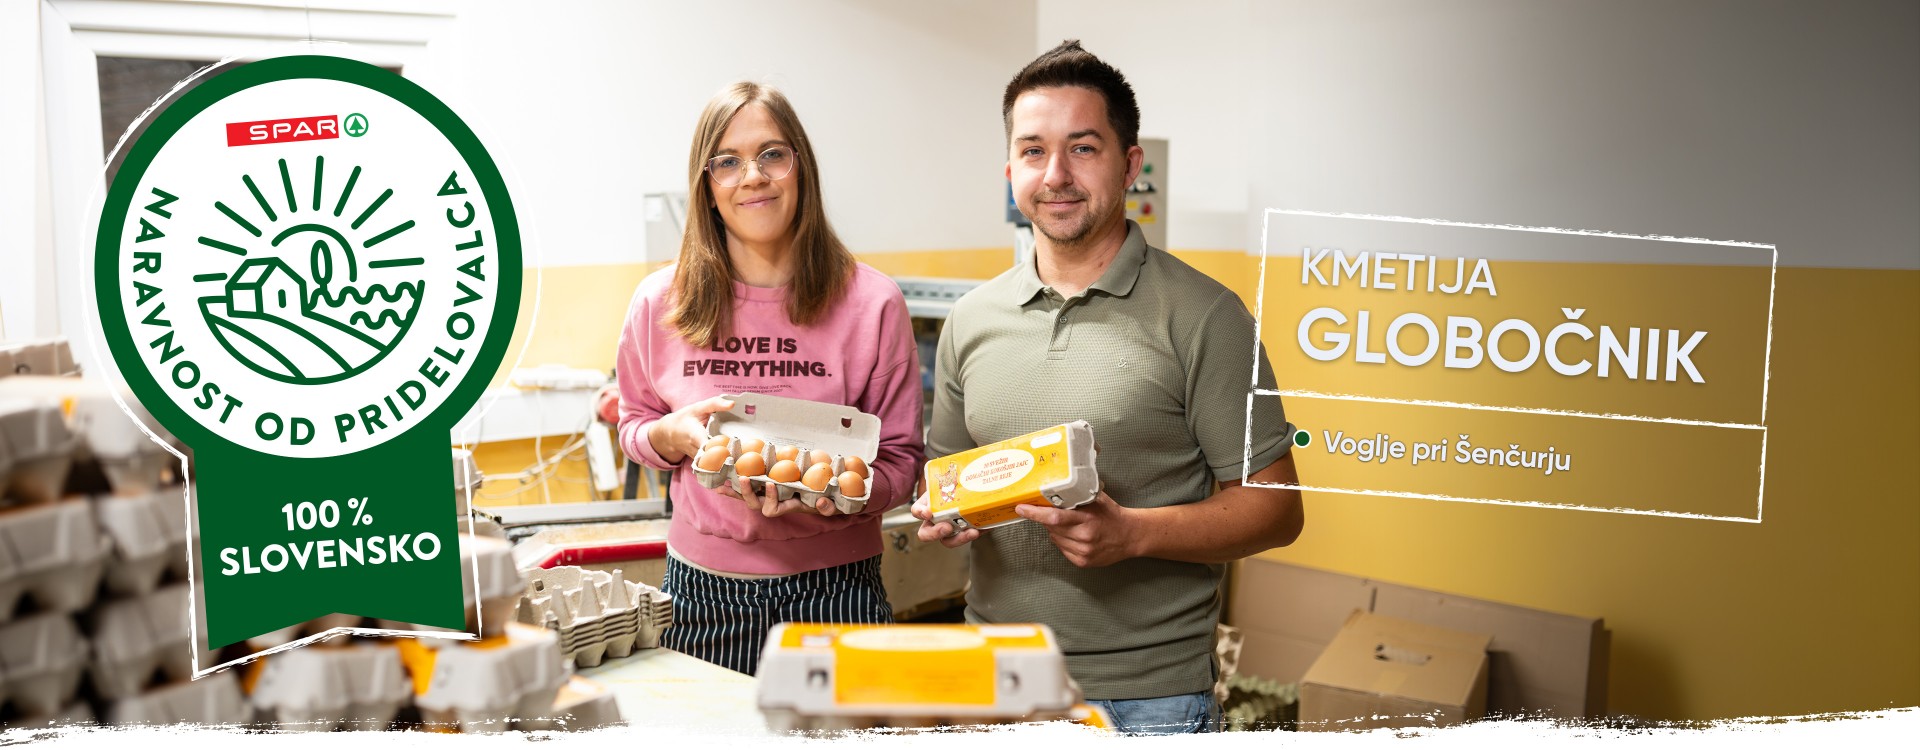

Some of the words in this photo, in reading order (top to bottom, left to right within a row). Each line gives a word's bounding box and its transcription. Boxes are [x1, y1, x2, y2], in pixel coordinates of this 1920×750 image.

[711, 337, 770, 354] LOVE
[776, 337, 798, 354] IS
[683, 359, 832, 377] EVERYTHING.
